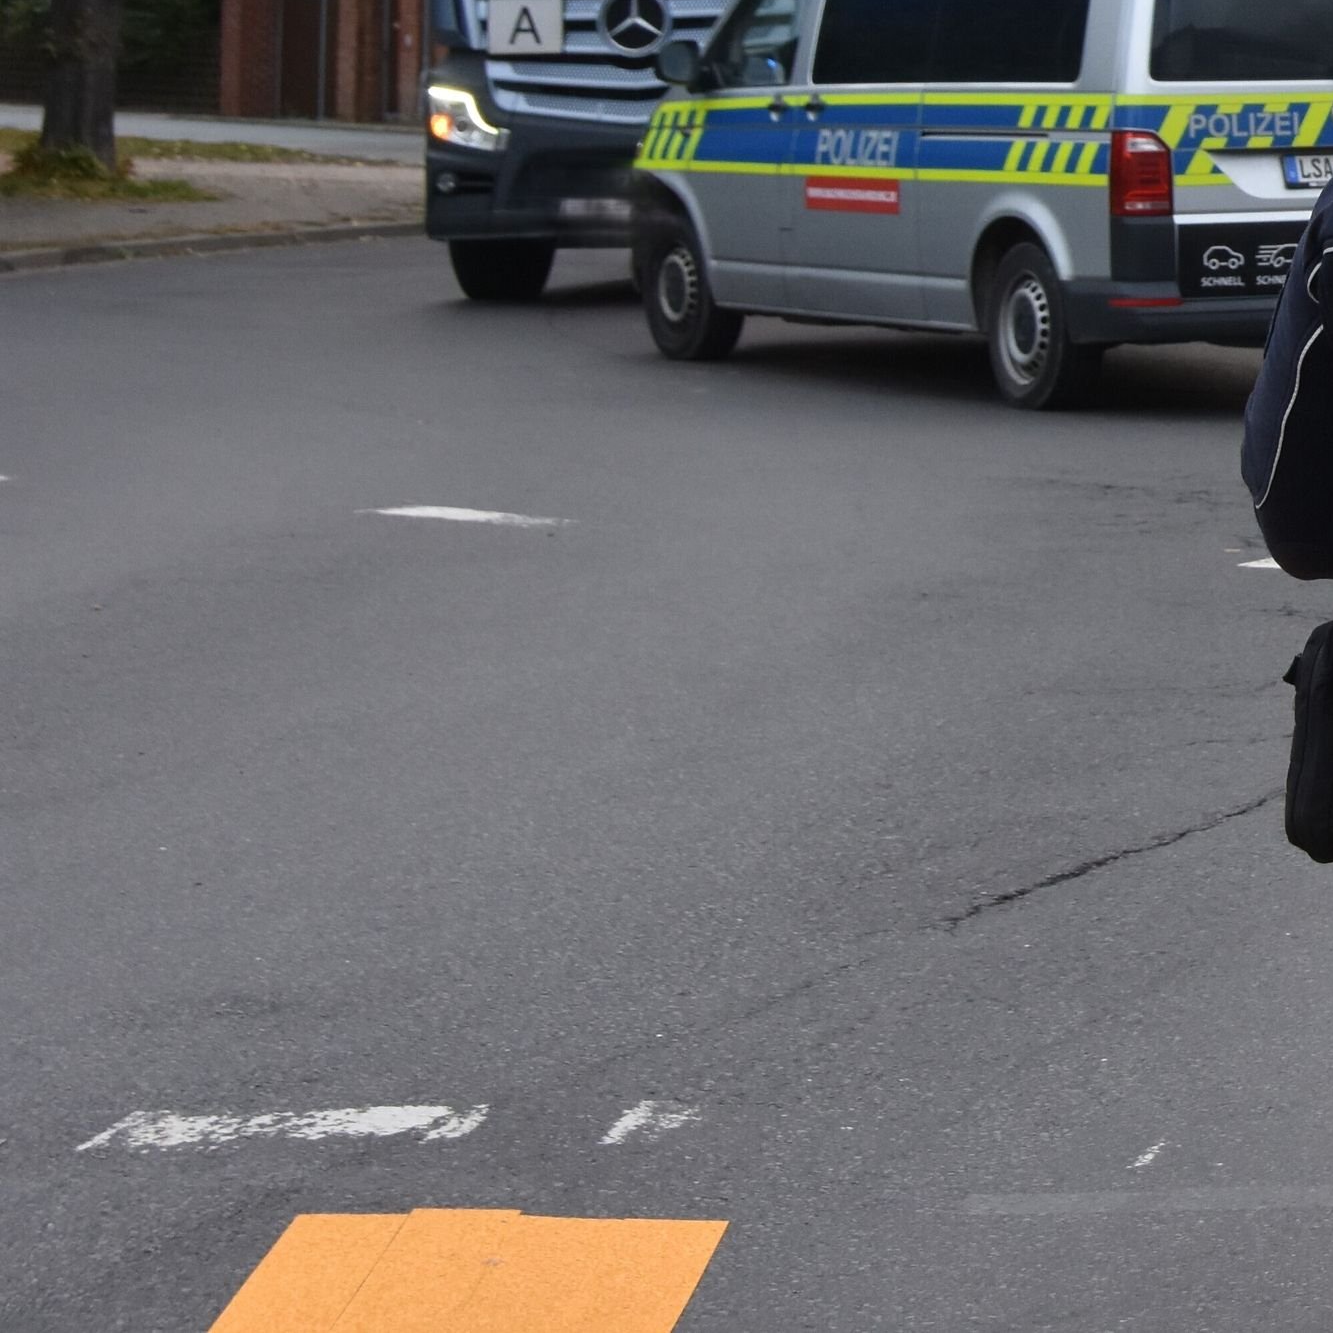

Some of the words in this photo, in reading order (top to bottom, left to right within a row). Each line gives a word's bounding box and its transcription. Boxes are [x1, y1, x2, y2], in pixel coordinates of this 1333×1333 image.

[509, 6, 541, 44] A
[1189, 112, 1299, 137] POLIZEI
[815, 129, 899, 166] POLIZEI
[1300, 157, 1333, 179] LSA
[1201, 277, 1245, 286] SCHNELL
[1256, 275, 1287, 285] SCHNE
